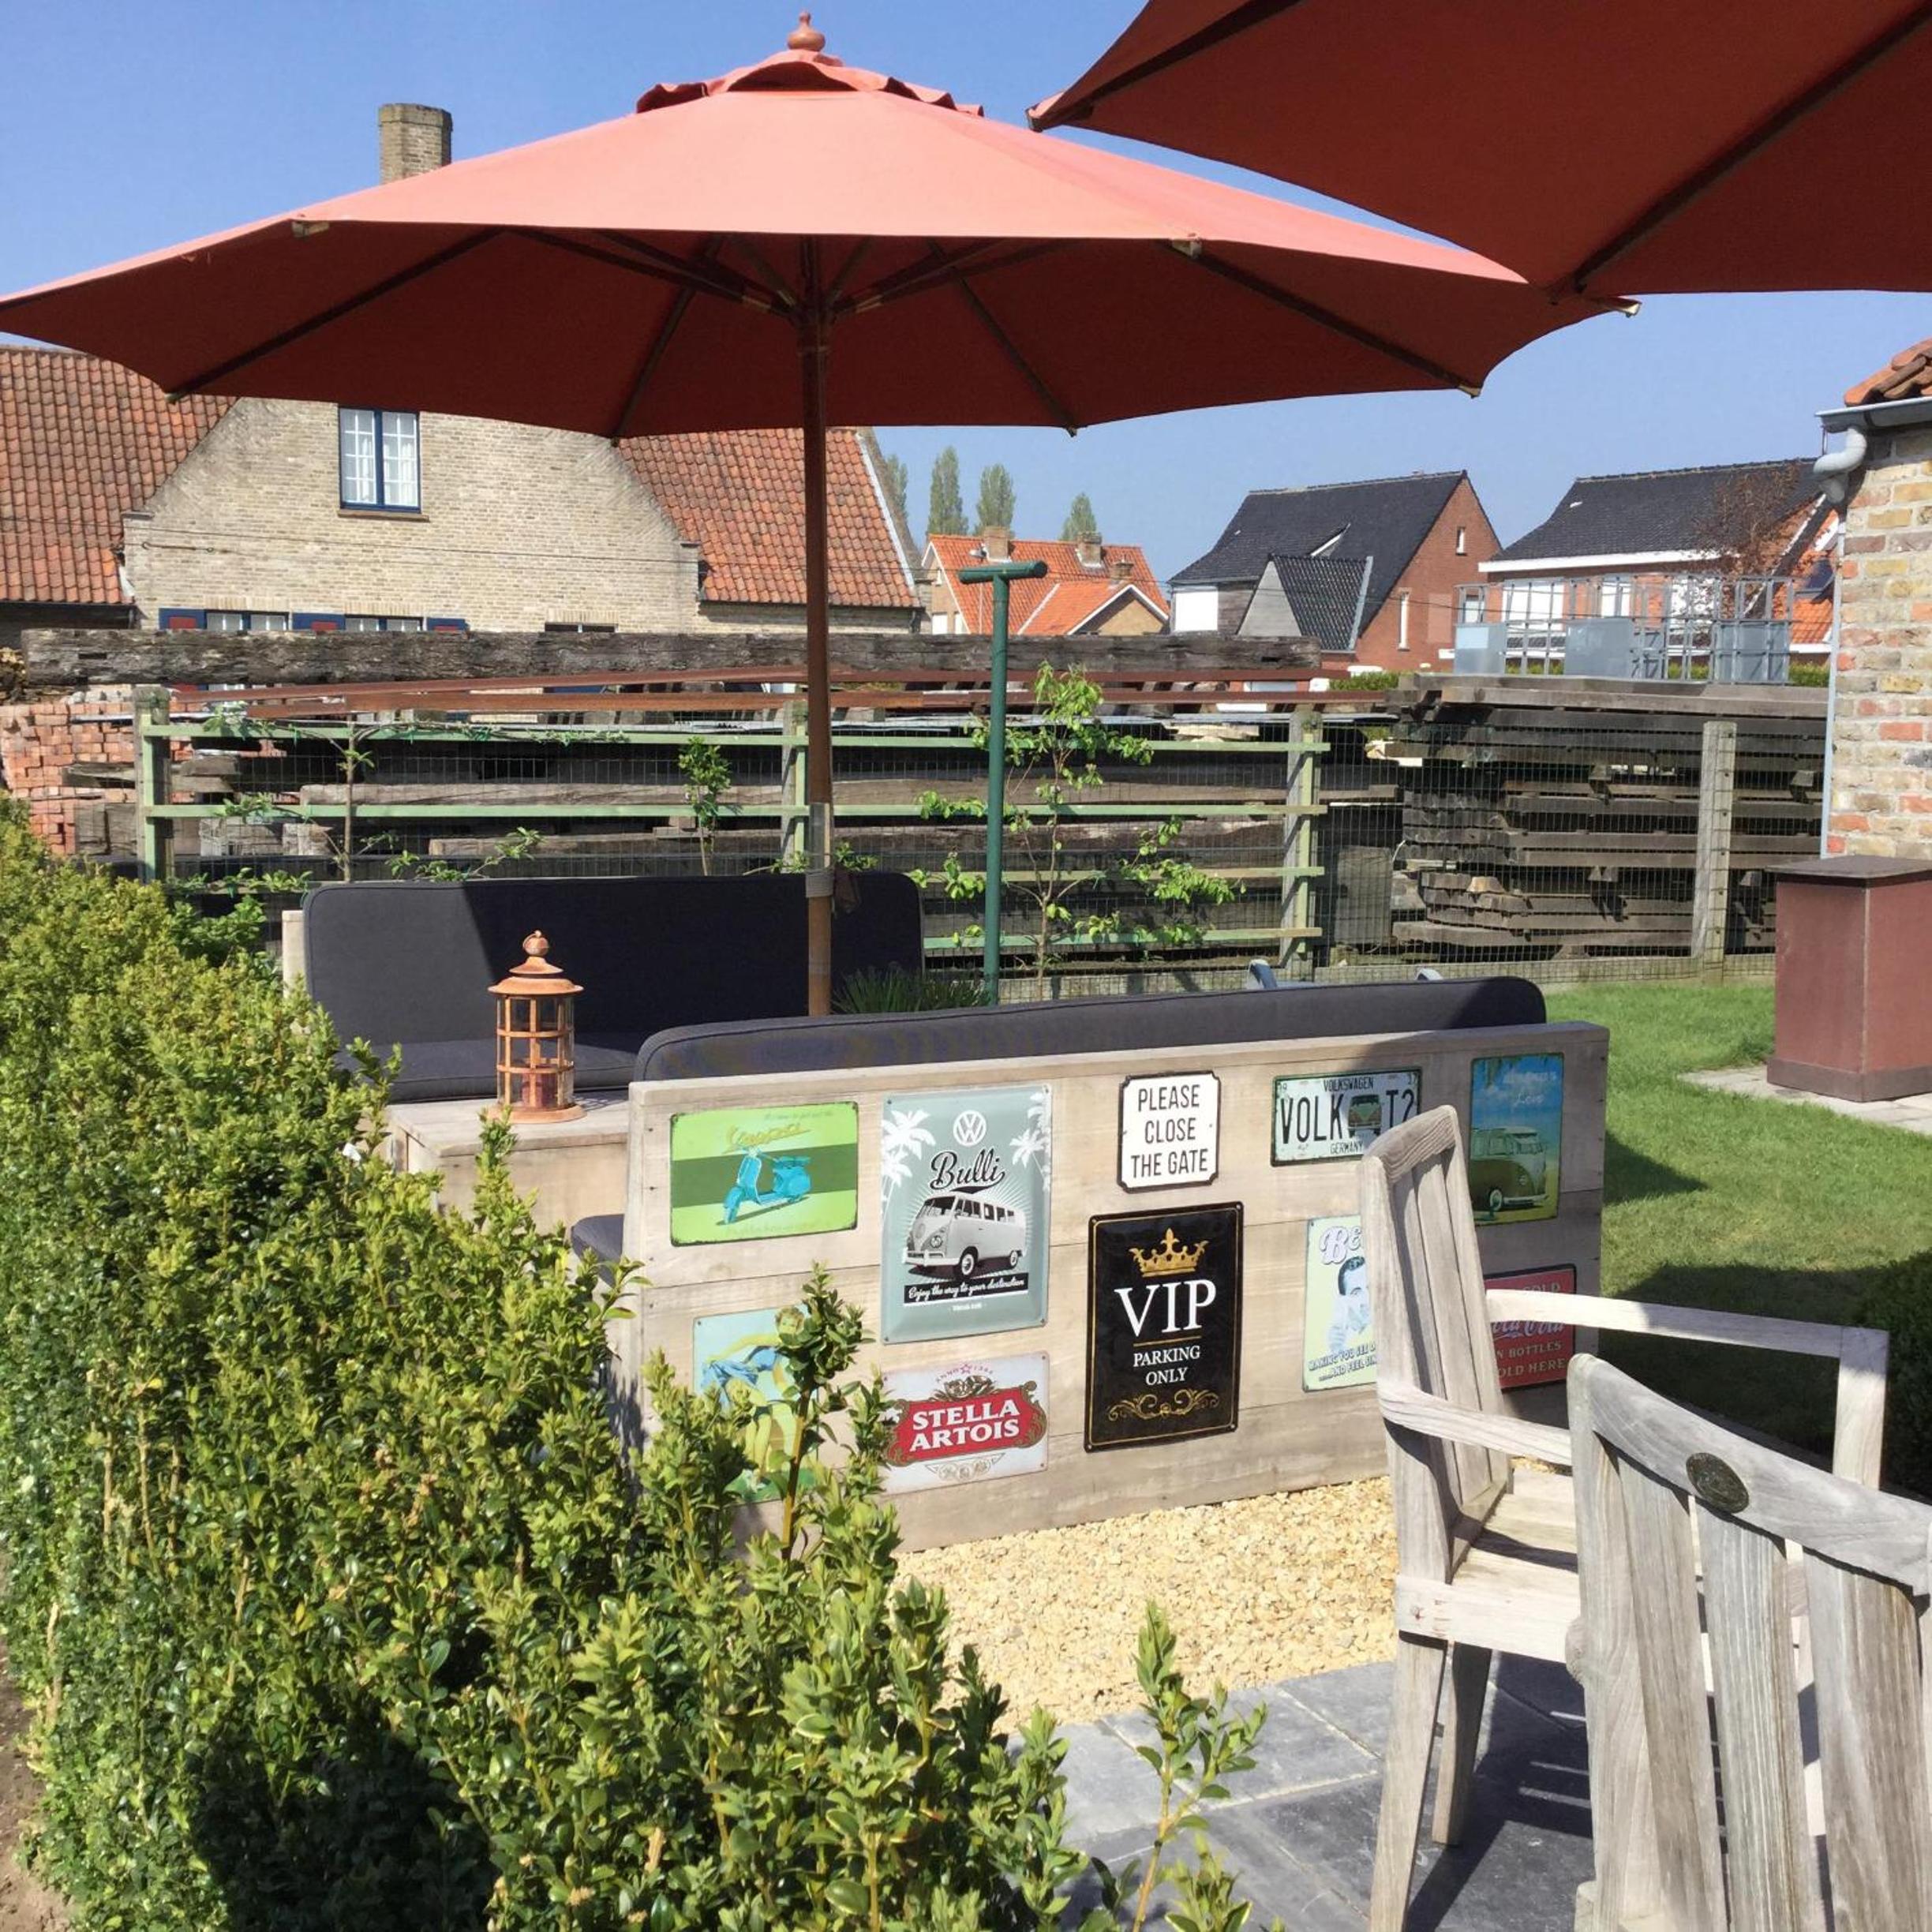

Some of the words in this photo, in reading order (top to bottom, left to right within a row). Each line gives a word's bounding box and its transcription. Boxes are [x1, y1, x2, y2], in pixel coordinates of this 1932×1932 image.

[1324, 1076, 1373, 1091] VOLKSWAGEN
[1138, 1084, 1200, 1112] PLEASE
[1280, 1094, 1344, 1144] VOLK
[1386, 1089, 1414, 1129] T2
[1144, 1117, 1196, 1144] CLOSE
[1330, 1141, 1364, 1154] GERMANY
[930, 1148, 1005, 1193] Bulli
[1131, 1152, 1163, 1178] THE
[1168, 1148, 1208, 1175] GATE
[908, 1286, 930, 1302] Enjoy
[931, 1284, 944, 1295] the
[945, 1286, 959, 1298] way
[960, 1282, 968, 1293] to
[968, 1283, 986, 1297] your
[987, 1276, 1024, 1290] destination
[1114, 1279, 1216, 1337] VIP
[1133, 1345, 1201, 1368] PARKING
[1509, 1341, 1563, 1358] BOTTLES
[1145, 1367, 1189, 1386] ONLY
[1498, 1365, 1524, 1378] OLD
[1529, 1358, 1566, 1374] HERE
[912, 1399, 1020, 1430] STELLA
[909, 1419, 1020, 1452] ARTOIS
